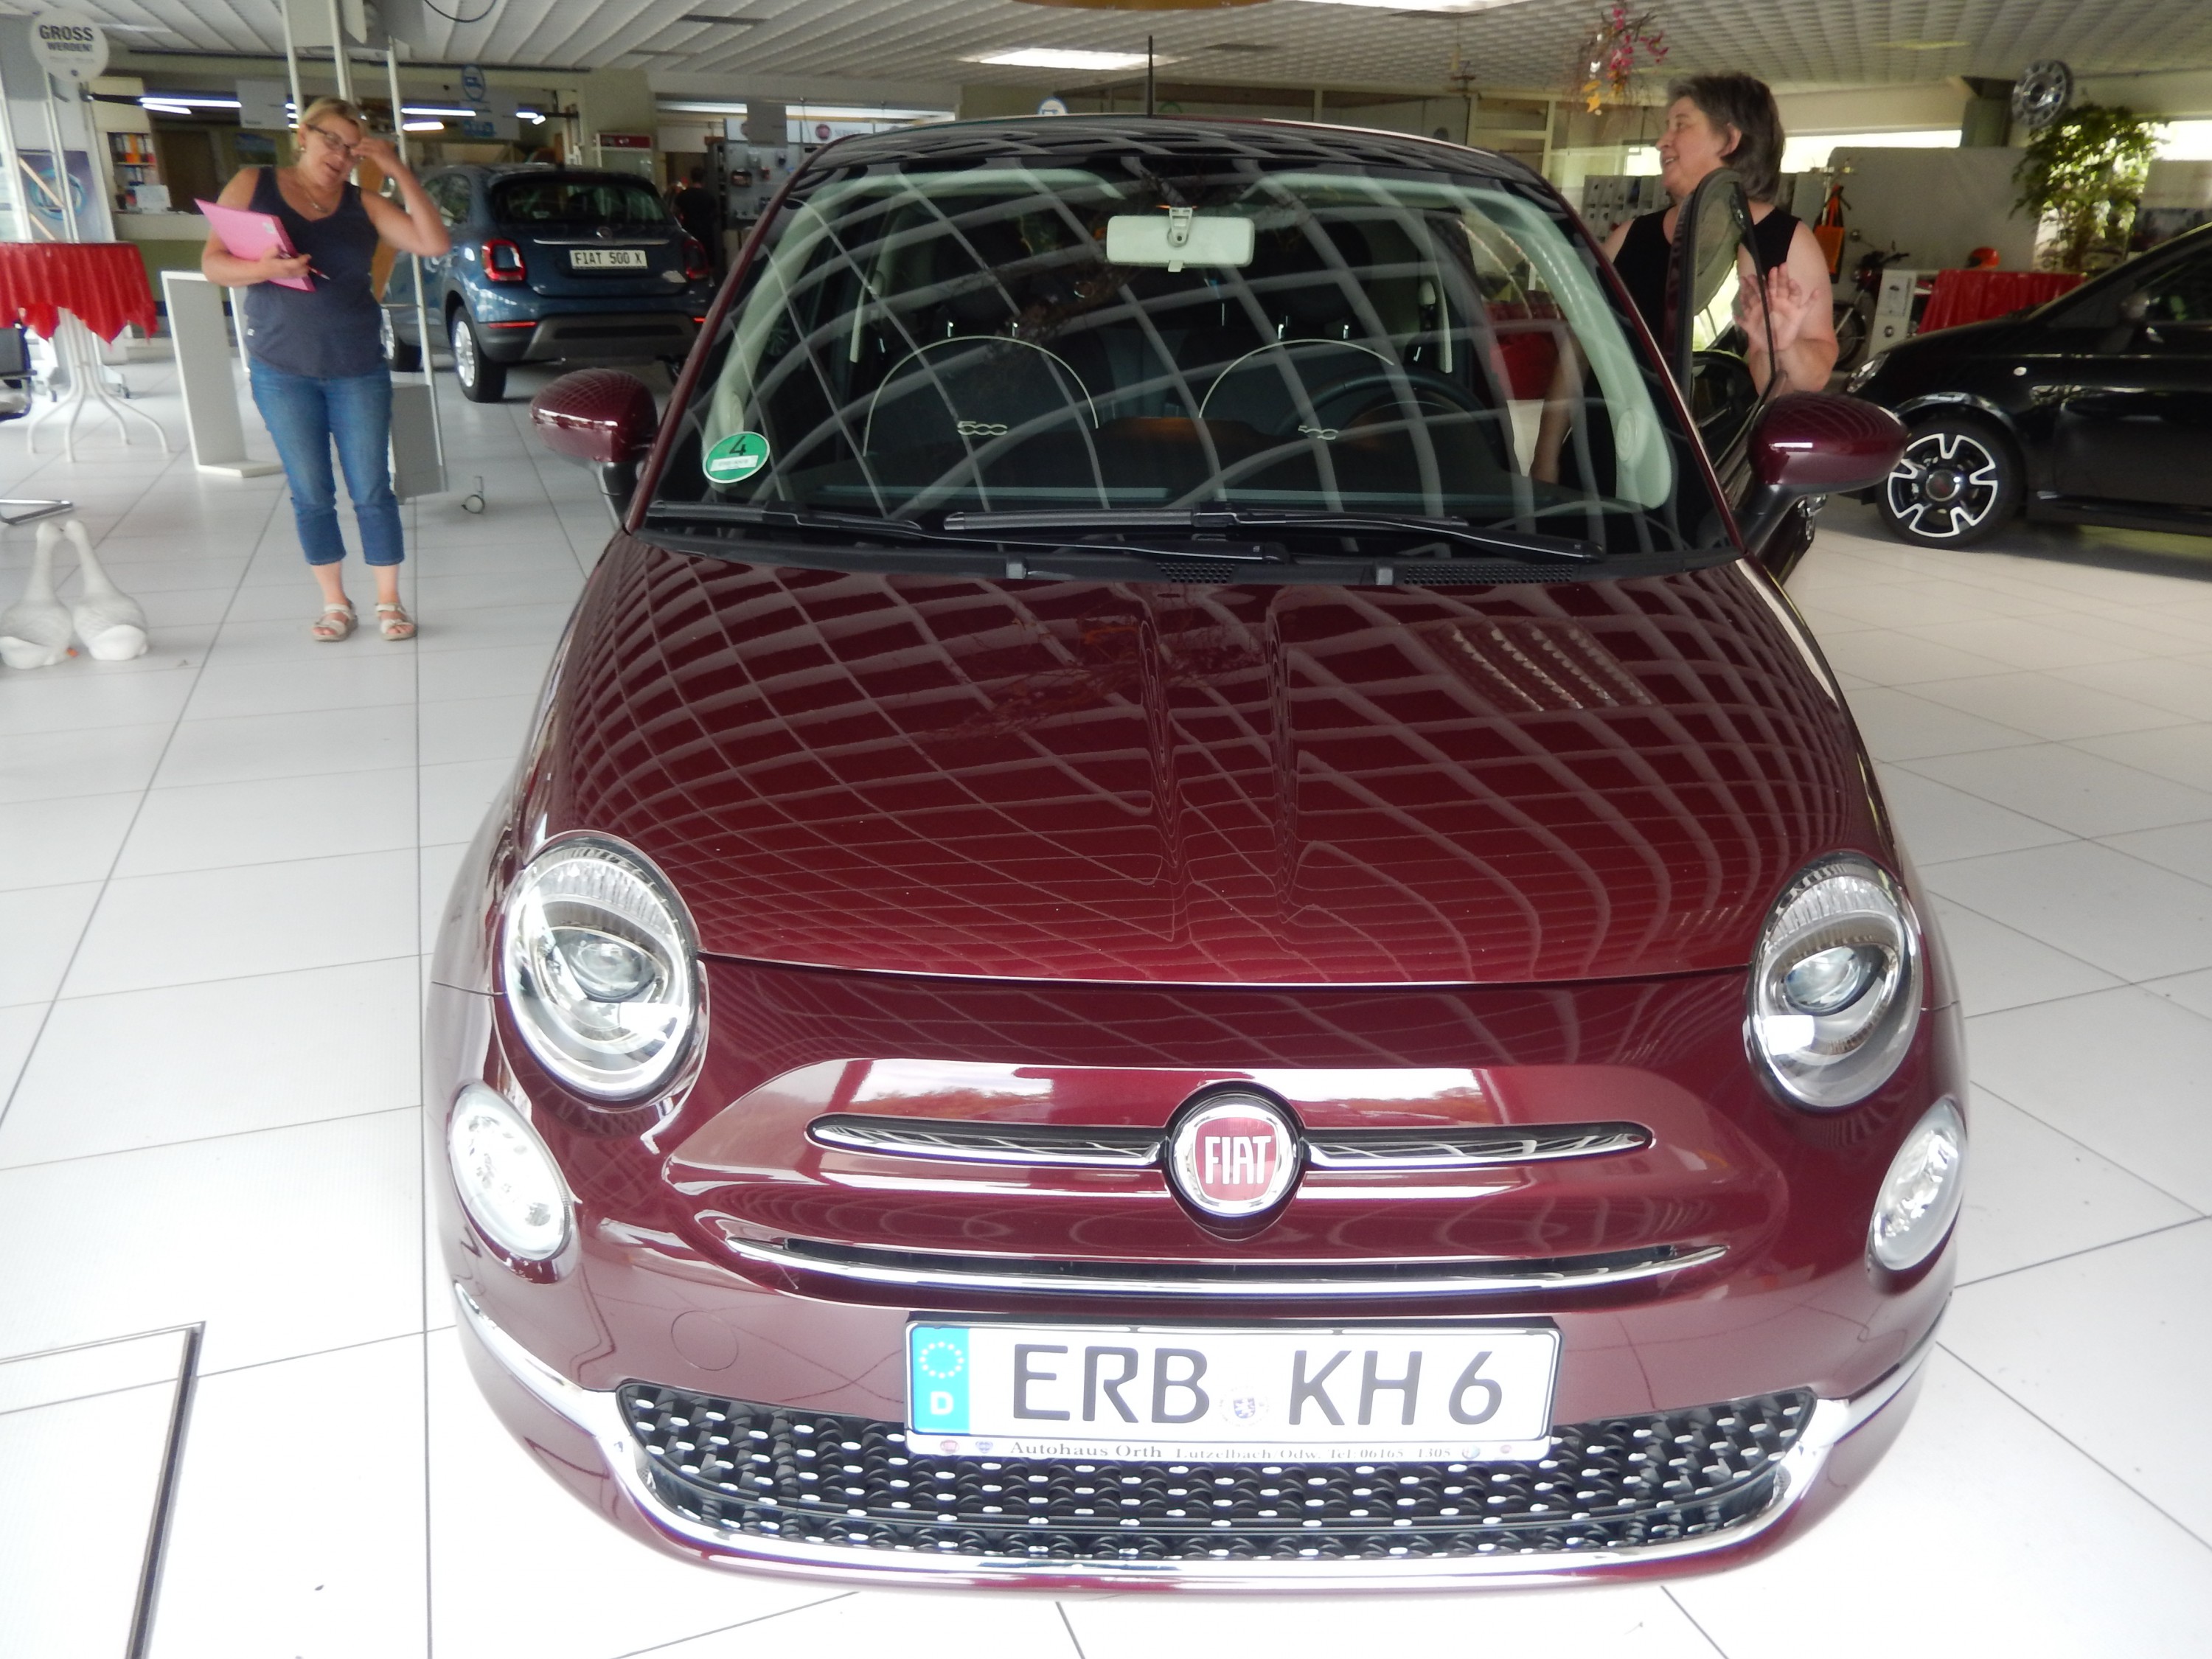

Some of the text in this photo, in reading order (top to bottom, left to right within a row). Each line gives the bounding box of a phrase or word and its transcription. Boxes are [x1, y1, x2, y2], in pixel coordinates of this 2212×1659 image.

[39, 24, 94, 41] GROSS
[574, 251, 642, 265] FIAT 500 X
[957, 420, 1009, 436] 500
[729, 435, 747, 456] 4
[1204, 1135, 1272, 1185] FIAT
[1013, 1343, 1211, 1424] ERB
[1288, 1349, 1424, 1426] KH
[1448, 1350, 1503, 1425] 6
[930, 1391, 954, 1416] D
[1009, 1441, 1109, 1457] Autohaus
[1115, 1443, 1162, 1458] Orth
